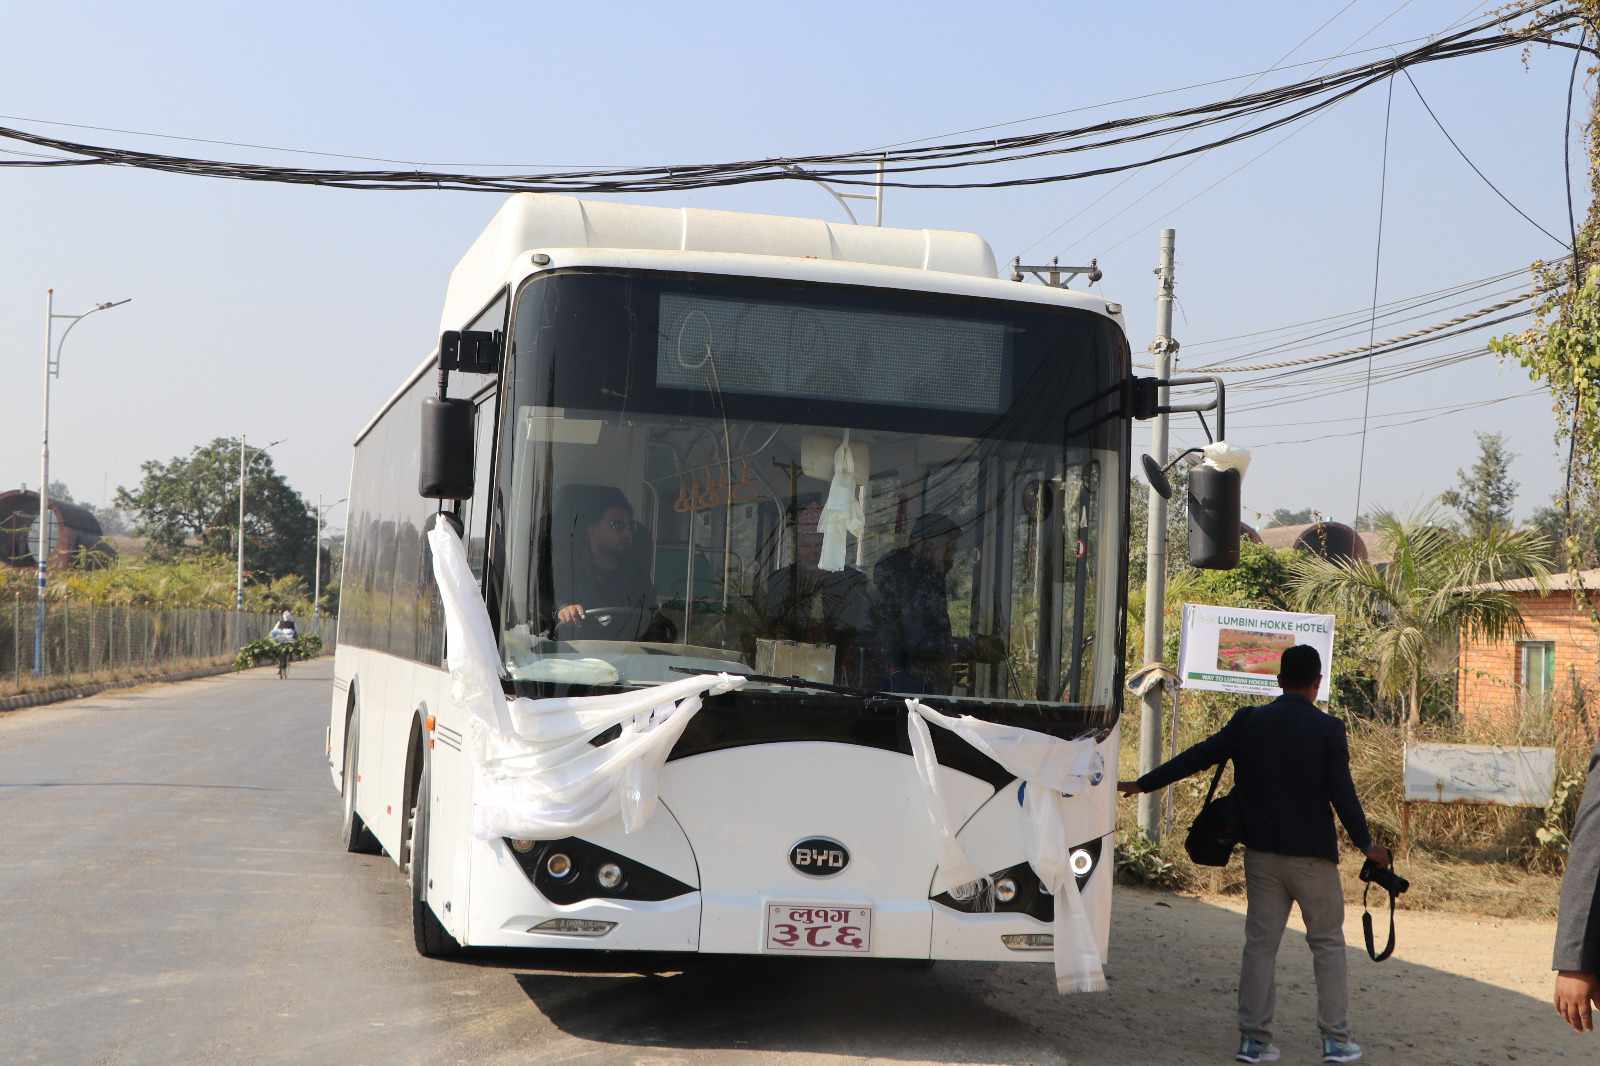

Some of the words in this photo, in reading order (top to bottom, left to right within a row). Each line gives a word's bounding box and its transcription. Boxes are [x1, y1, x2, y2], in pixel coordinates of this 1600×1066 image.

[1218, 615, 1257, 628] LUMBINI
[1260, 620, 1293, 631] HOKKE
[1295, 623, 1328, 634] HOTEL
[795, 847, 844, 867] BYD
[772, 923, 864, 949] ३८६
